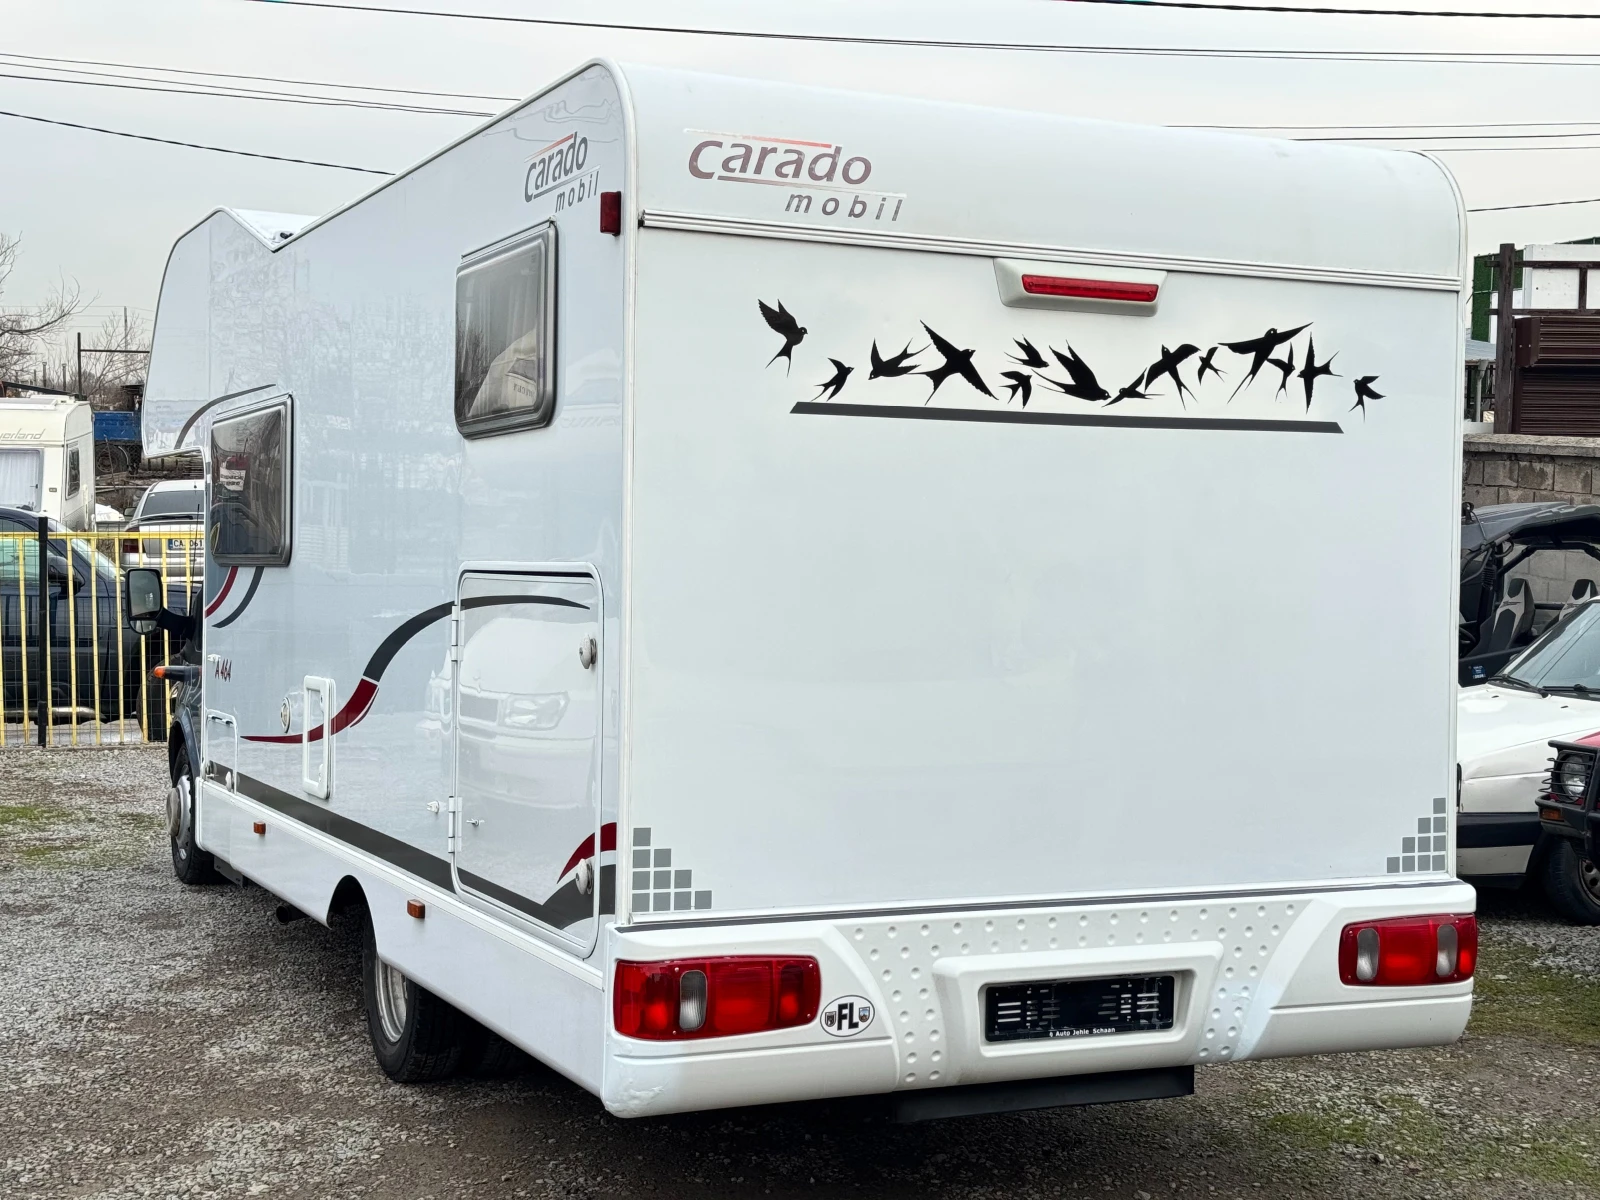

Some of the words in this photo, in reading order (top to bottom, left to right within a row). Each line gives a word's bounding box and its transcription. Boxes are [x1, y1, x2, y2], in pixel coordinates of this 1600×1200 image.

[555, 170, 599, 213] mobil
[785, 193, 903, 222] mobil
[214, 658, 220, 680] A
[220, 658, 232, 682] 464
[837, 1002, 859, 1031] FL
